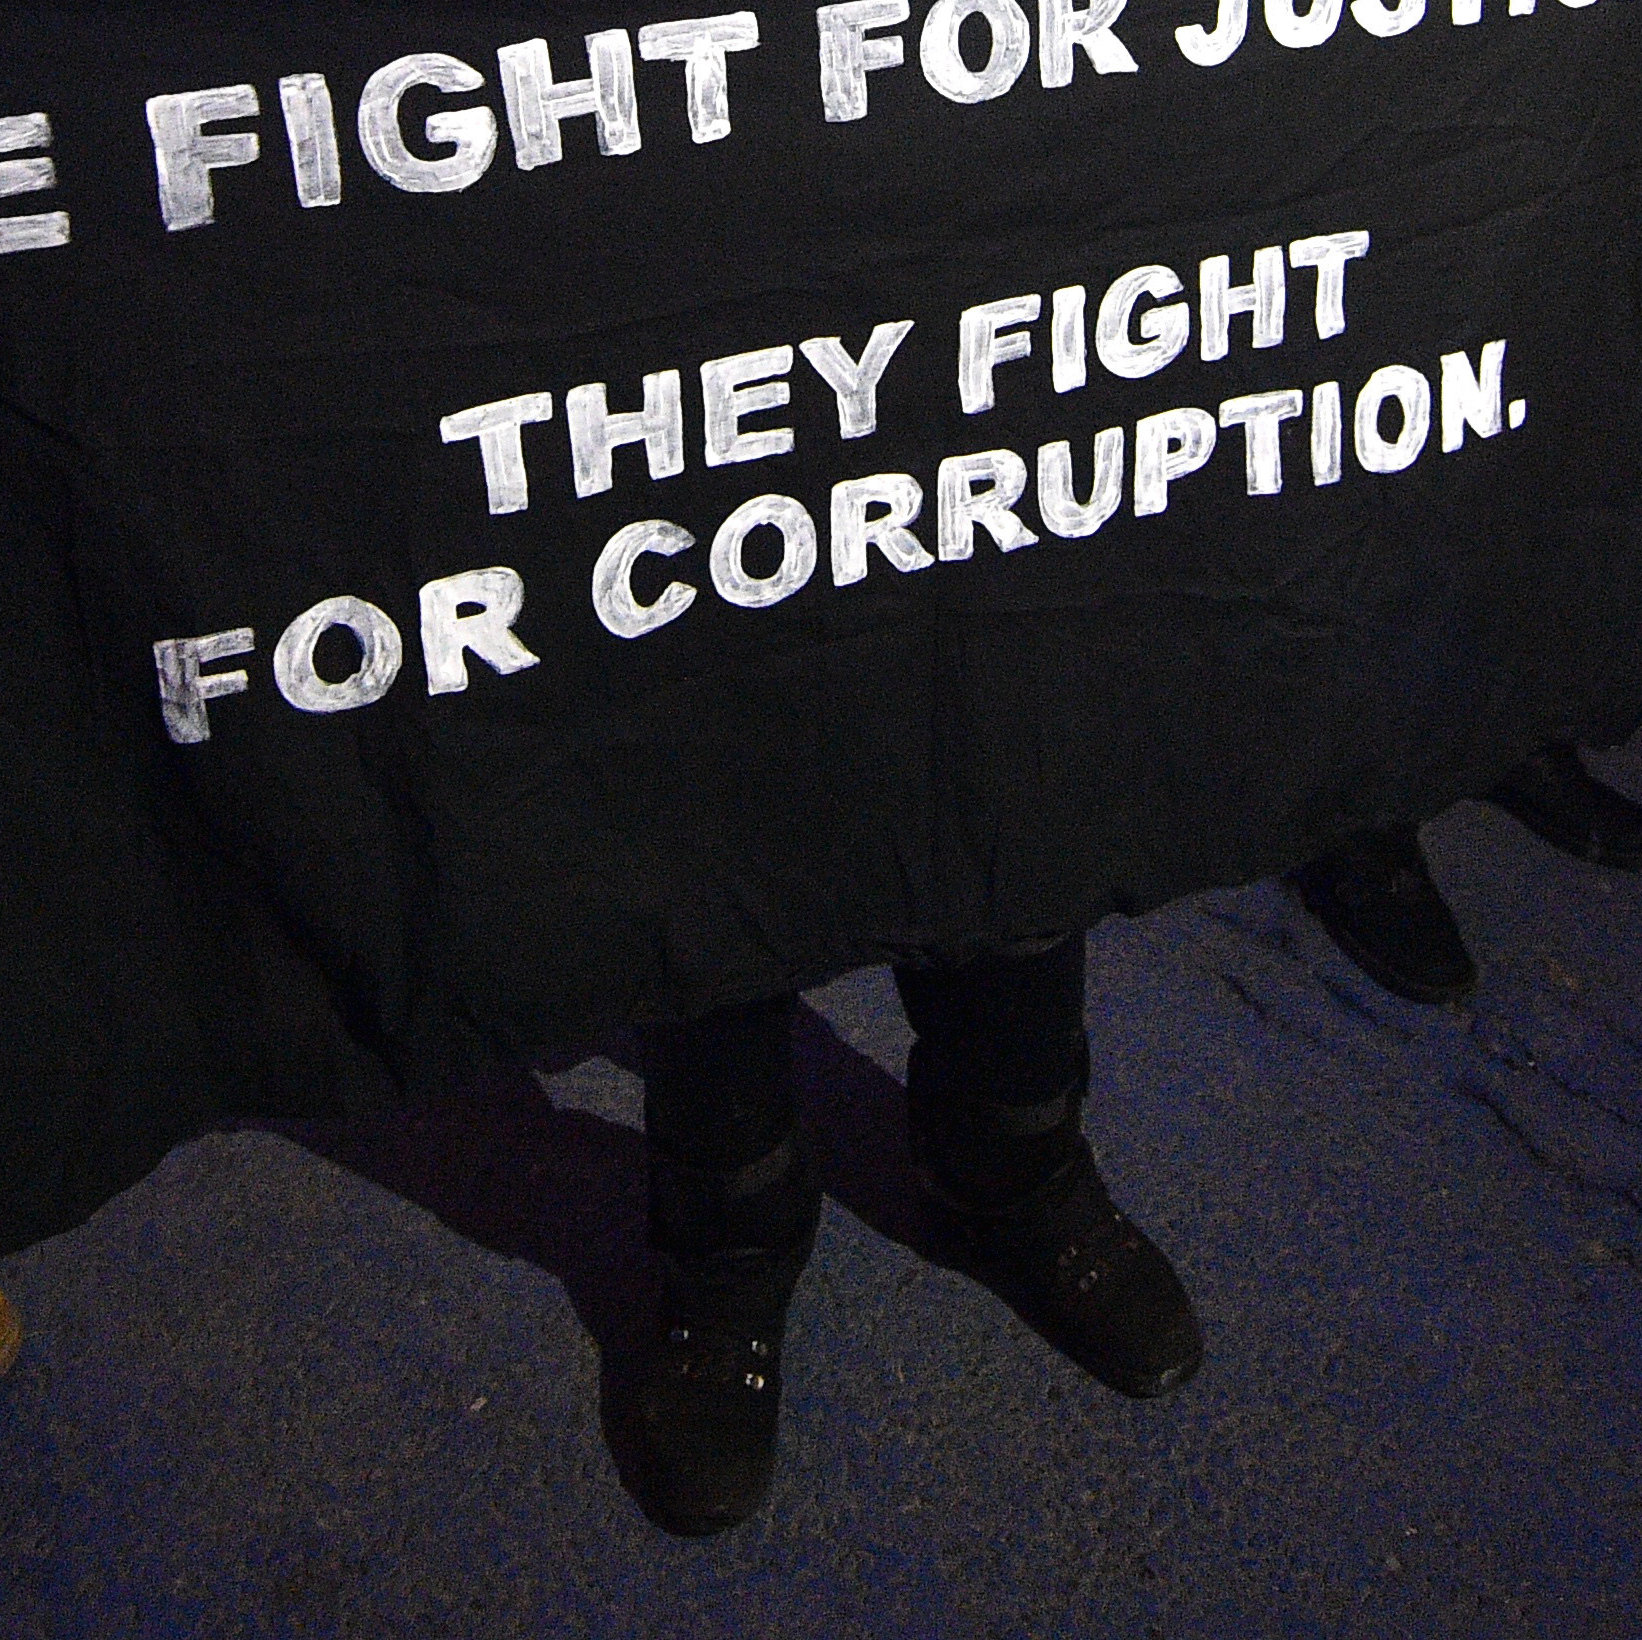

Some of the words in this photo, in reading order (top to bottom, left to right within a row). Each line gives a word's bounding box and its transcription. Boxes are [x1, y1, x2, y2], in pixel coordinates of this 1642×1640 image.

[143, 8, 762, 233] FIGHT
[437, 317, 916, 517] THEY
[955, 228, 1372, 416] FIGHT
[152, 564, 542, 746] FOR
[590, 337, 1528, 641] CORRUPTION.
